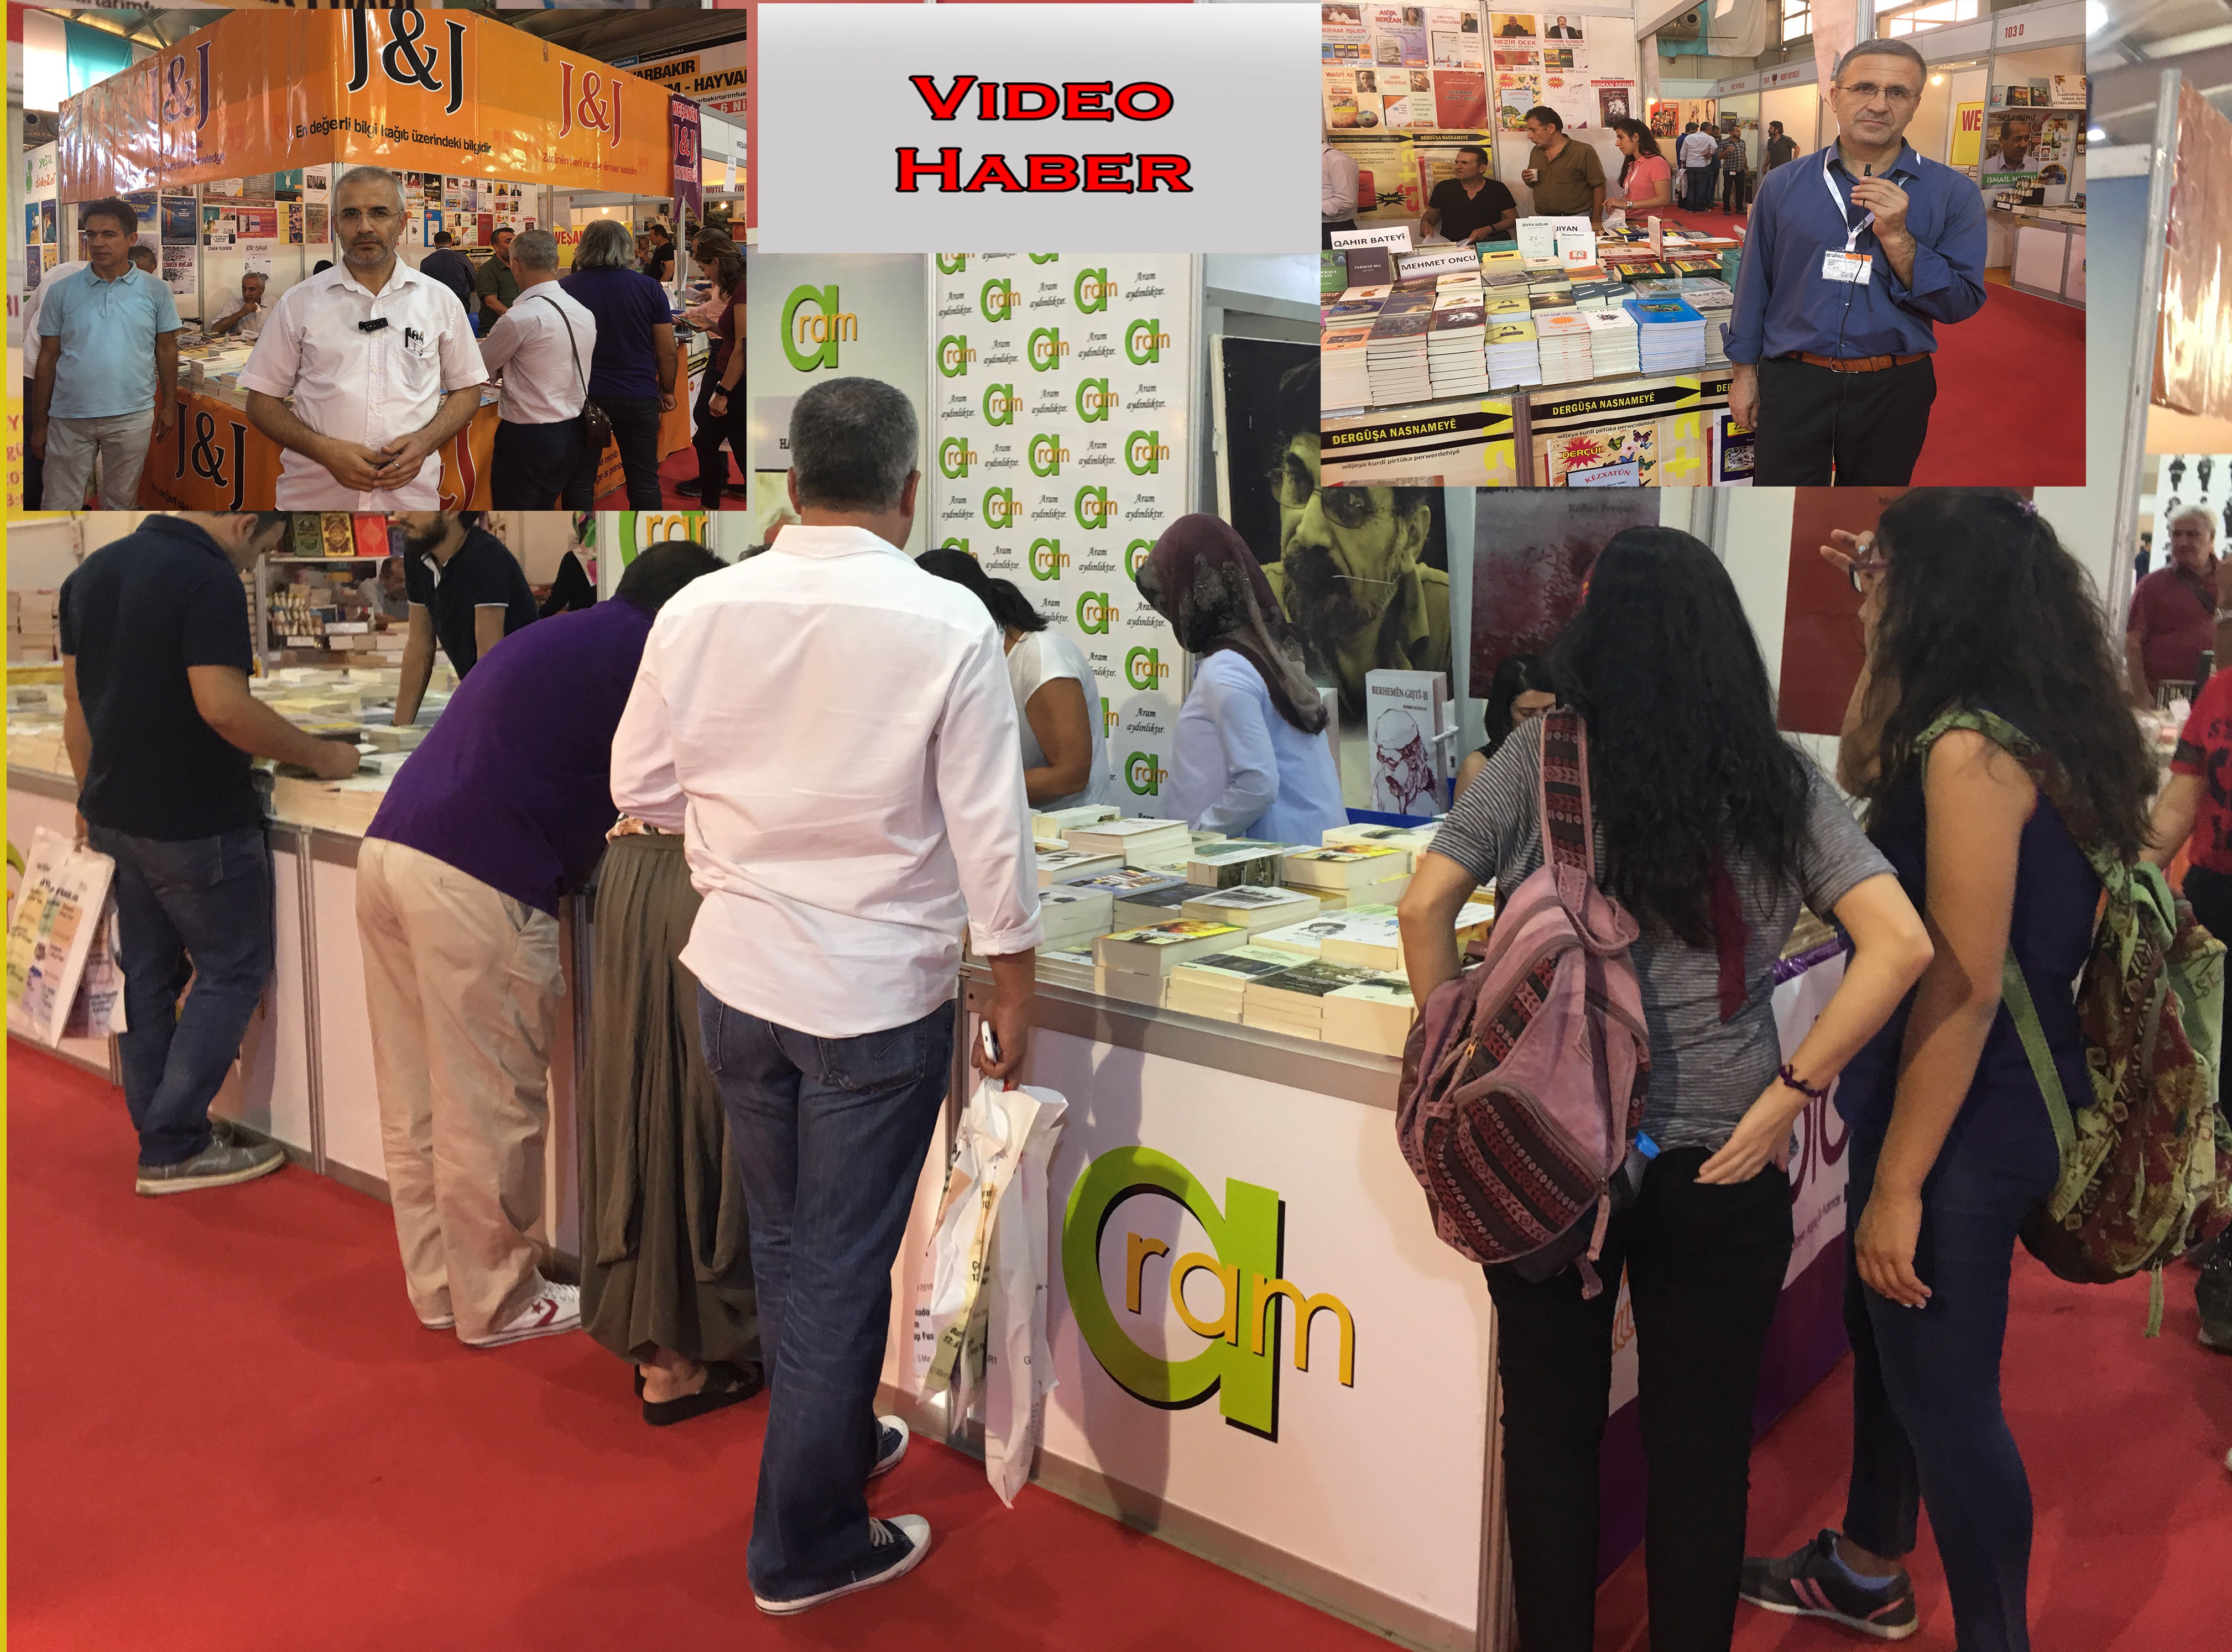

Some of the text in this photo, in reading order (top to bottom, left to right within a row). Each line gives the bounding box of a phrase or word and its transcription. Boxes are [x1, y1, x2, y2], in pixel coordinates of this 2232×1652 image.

[2004, 23, 2025, 39] 103 D
[346, 9, 466, 116] J&J
[694, 69, 747, 92] HAYVA
[559, 60, 623, 149] J&J
[720, 103, 728, 113] 6
[296, 116, 491, 155] En değerli bilgi kağıt üzerindeki bilgidir
[674, 124, 696, 164] J&J
[1986, 174, 2011, 184] İSMAİL
[1333, 233, 1405, 247] QAHIR BATEYÎ
[1401, 255, 1477, 270] MEHMET ONCU
[1134, 271, 1156, 283] Aram
[1038, 282, 1057, 292] Aram
[946, 291, 964, 302] Aram
[1086, 332, 1107, 343] Aram
[992, 339, 1010, 350] Aram
[1040, 389, 1059, 399] Aram
[1135, 384, 1157, 395] Aram
[948, 394, 967, 404] Aram
[1552, 392, 1655, 415] DERGÛŞA NASNAMEYÊ
[1332, 419, 1457, 445] DERGÛŞA NASNAMEYÊ
[993, 443, 1011, 453] Aram
[1086, 440, 1107, 451] Aram
[175, 401, 248, 511] J&J
[605, 450, 618, 463] most
[1368, 458, 1386, 466] kurdî
[1388, 454, 1413, 466] pirtûka
[1414, 449, 1461, 462] perwerdehiyê
[1584, 468, 1631, 484] KÊZXATÛN
[949, 496, 967, 505] Aram
[1039, 494, 1058, 505] Aram
[1134, 493, 1155, 504] Aram
[993, 546, 1011, 556] Aram
[1087, 546, 1107, 557] Aram
[1041, 598, 1060, 608] Aram
[1088, 651, 1108, 662] Aram
[1135, 707, 1156, 718] Aram
